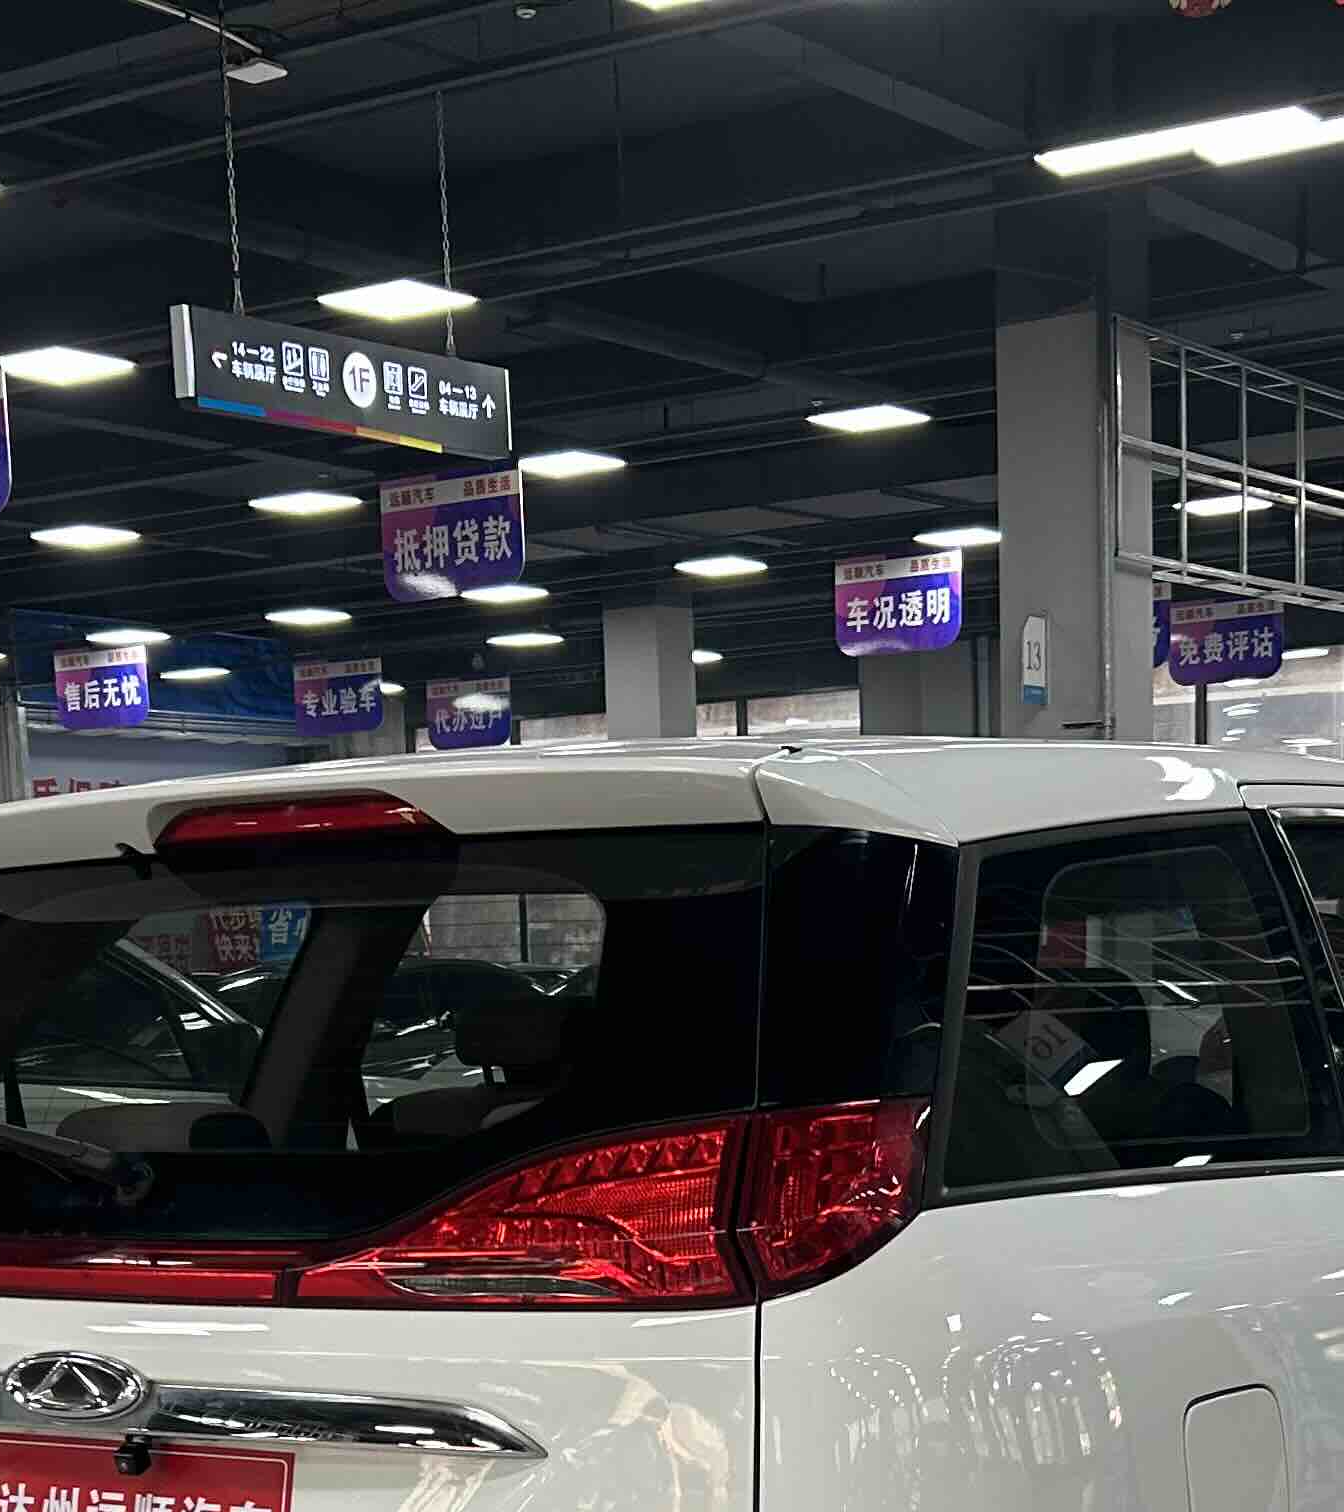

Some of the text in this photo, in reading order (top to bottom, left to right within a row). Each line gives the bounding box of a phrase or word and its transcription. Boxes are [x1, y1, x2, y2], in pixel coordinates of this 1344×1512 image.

[349, 365, 371, 393] 1F
[393, 514, 513, 574] 抵押贷款
[846, 587, 952, 633] 车况透明
[1026, 640, 1042, 671] 13
[63, 674, 142, 712] 售后无忧
[302, 685, 378, 718] 专业验车
